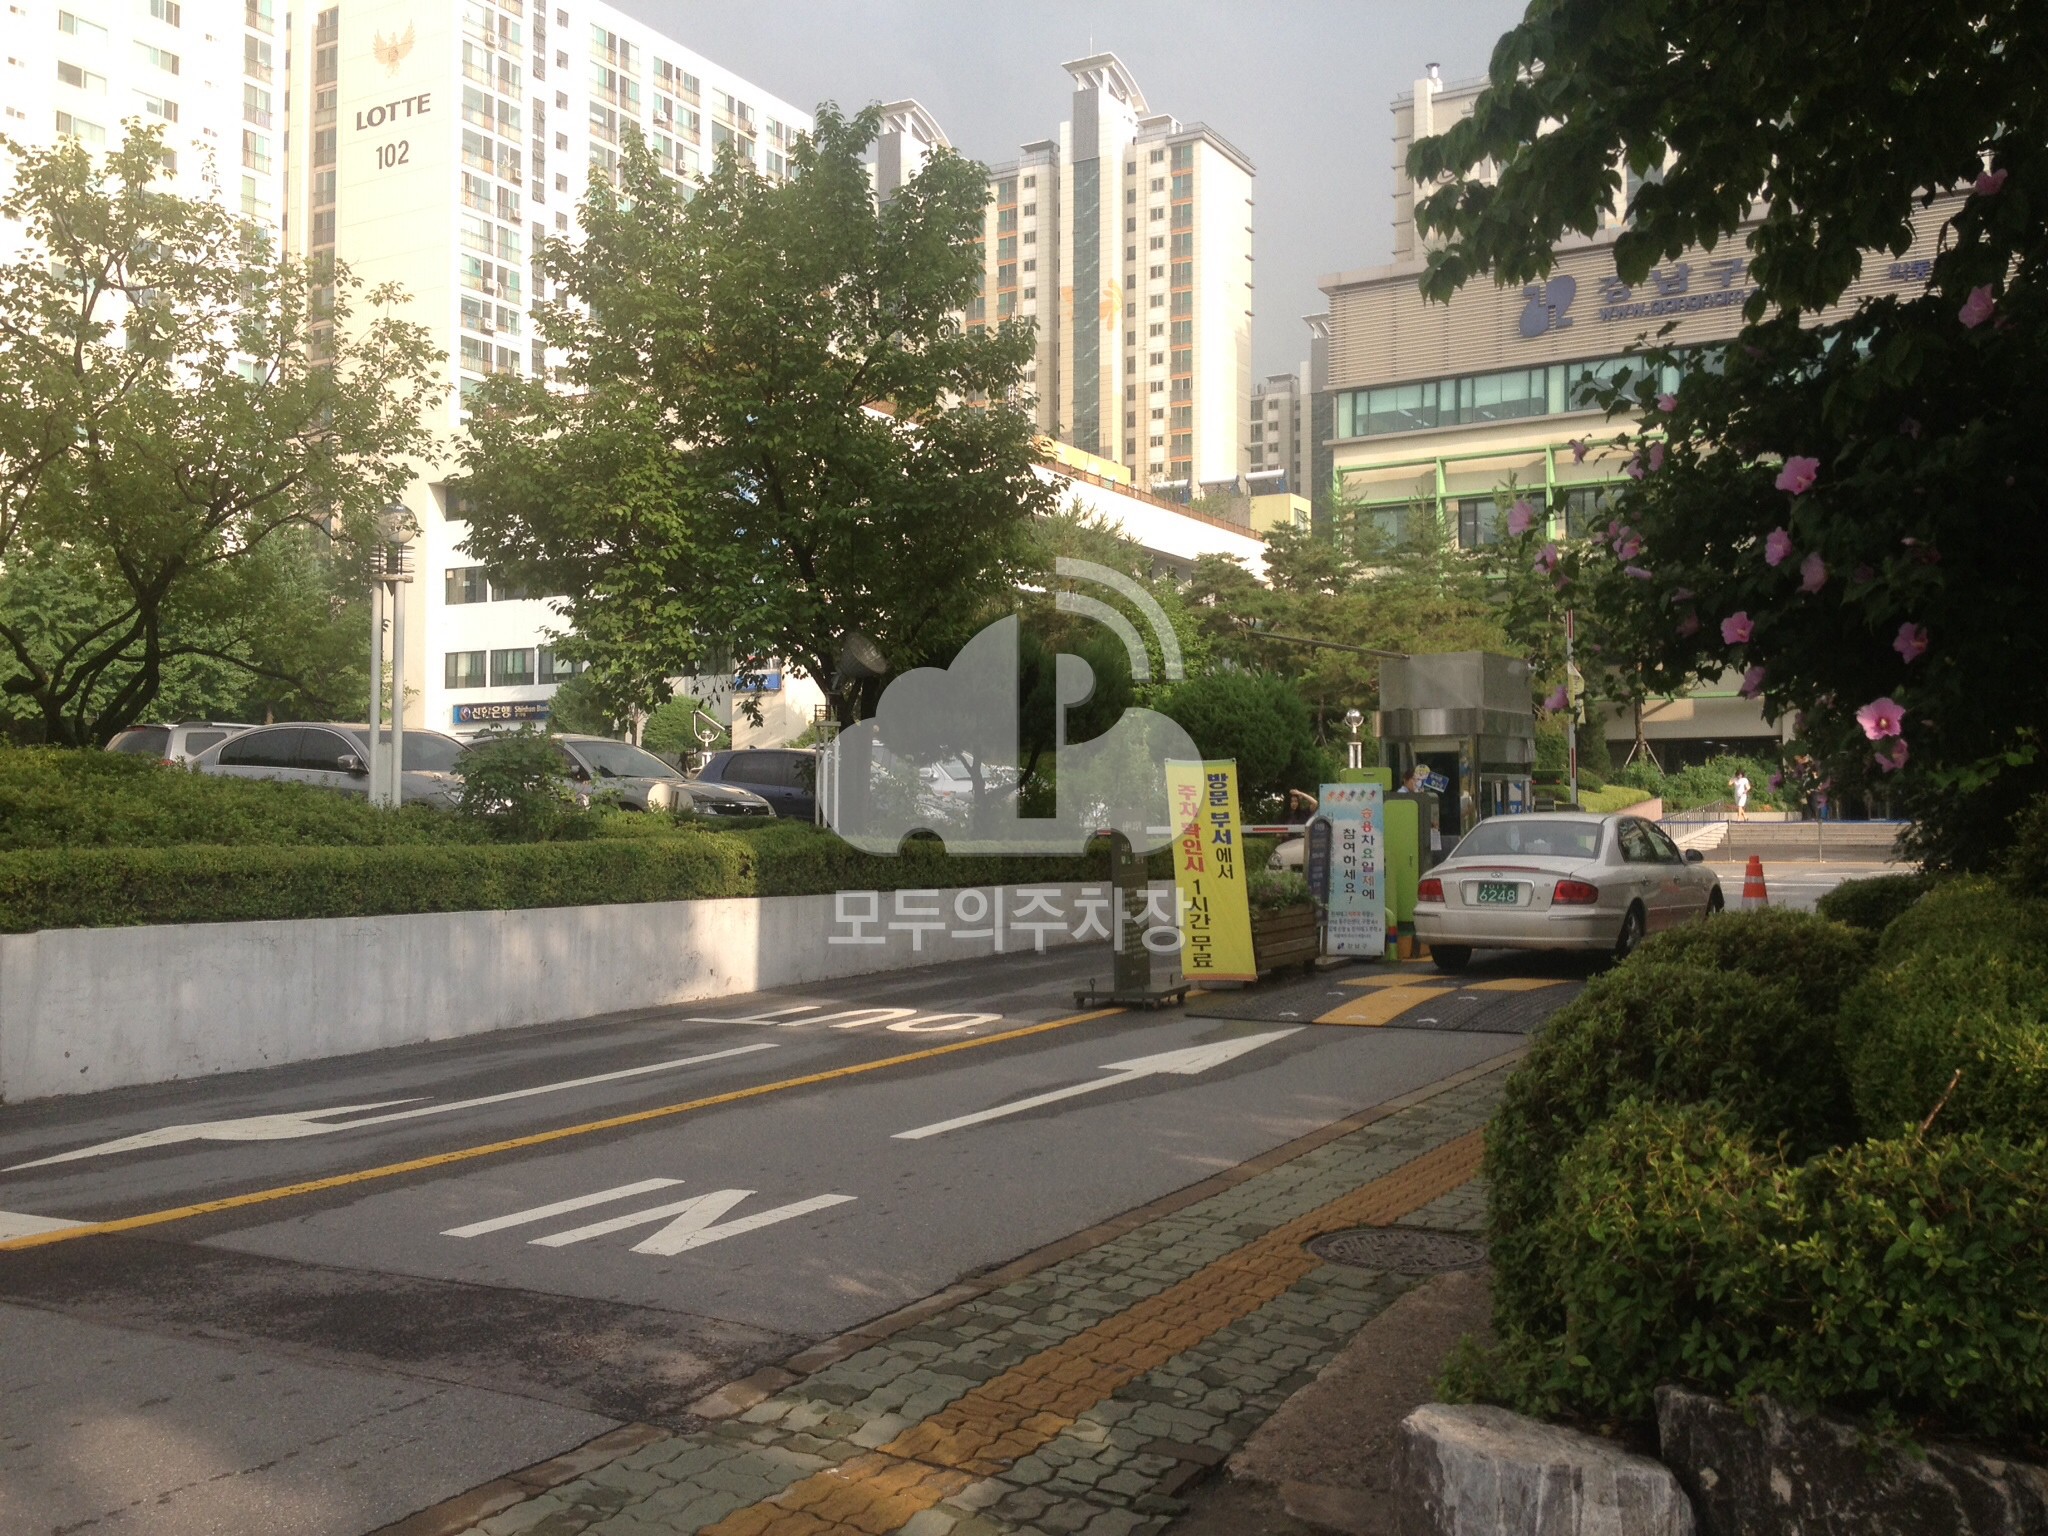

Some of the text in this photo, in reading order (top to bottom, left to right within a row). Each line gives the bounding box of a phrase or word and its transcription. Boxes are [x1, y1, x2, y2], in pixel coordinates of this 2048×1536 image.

[356, 92, 431, 131] LOTTE
[375, 139, 410, 170] 102
[472, 705, 511, 720] 신한은행
[514, 705, 536, 713] Shinhan
[1206, 773, 1234, 879] 방문 부서에서
[1177, 784, 1200, 818] 주차
[1191, 935, 1214, 968] 무료
[1342, 828, 1357, 905] 참여하세요!
[1479, 889, 1516, 902] 6248
[440, 1178, 858, 1256] IN
